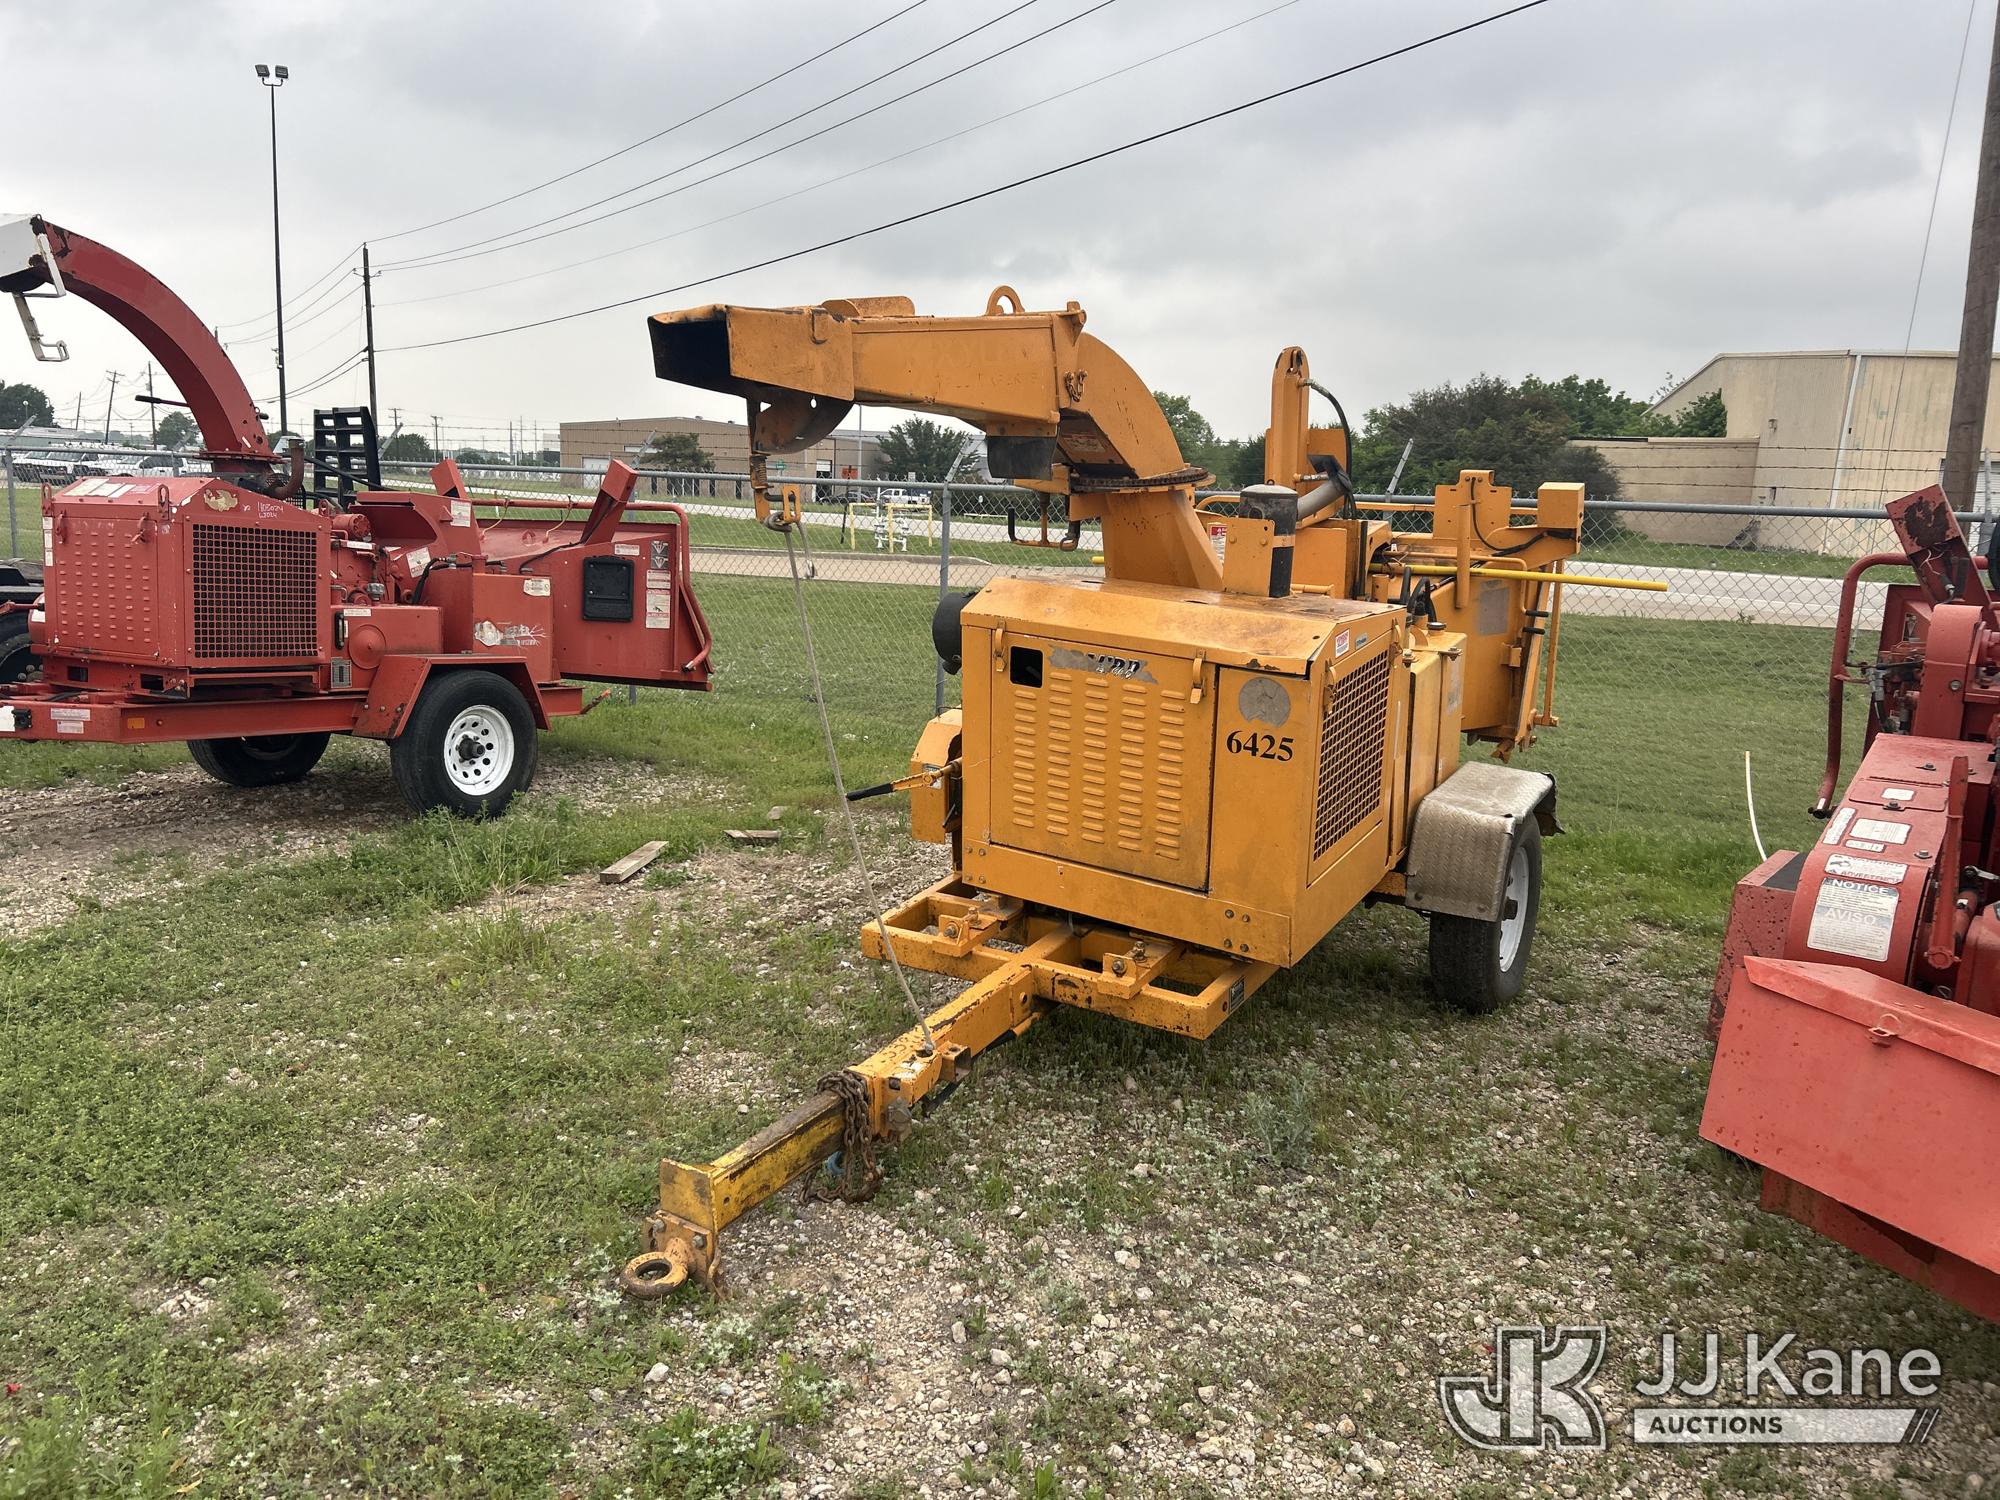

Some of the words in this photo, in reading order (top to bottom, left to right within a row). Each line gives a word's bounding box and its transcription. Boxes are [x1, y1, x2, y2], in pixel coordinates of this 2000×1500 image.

[1226, 730, 1295, 762] 6425
[1831, 879, 1890, 894] NOTICE
[1825, 907, 1877, 925] AVISO
